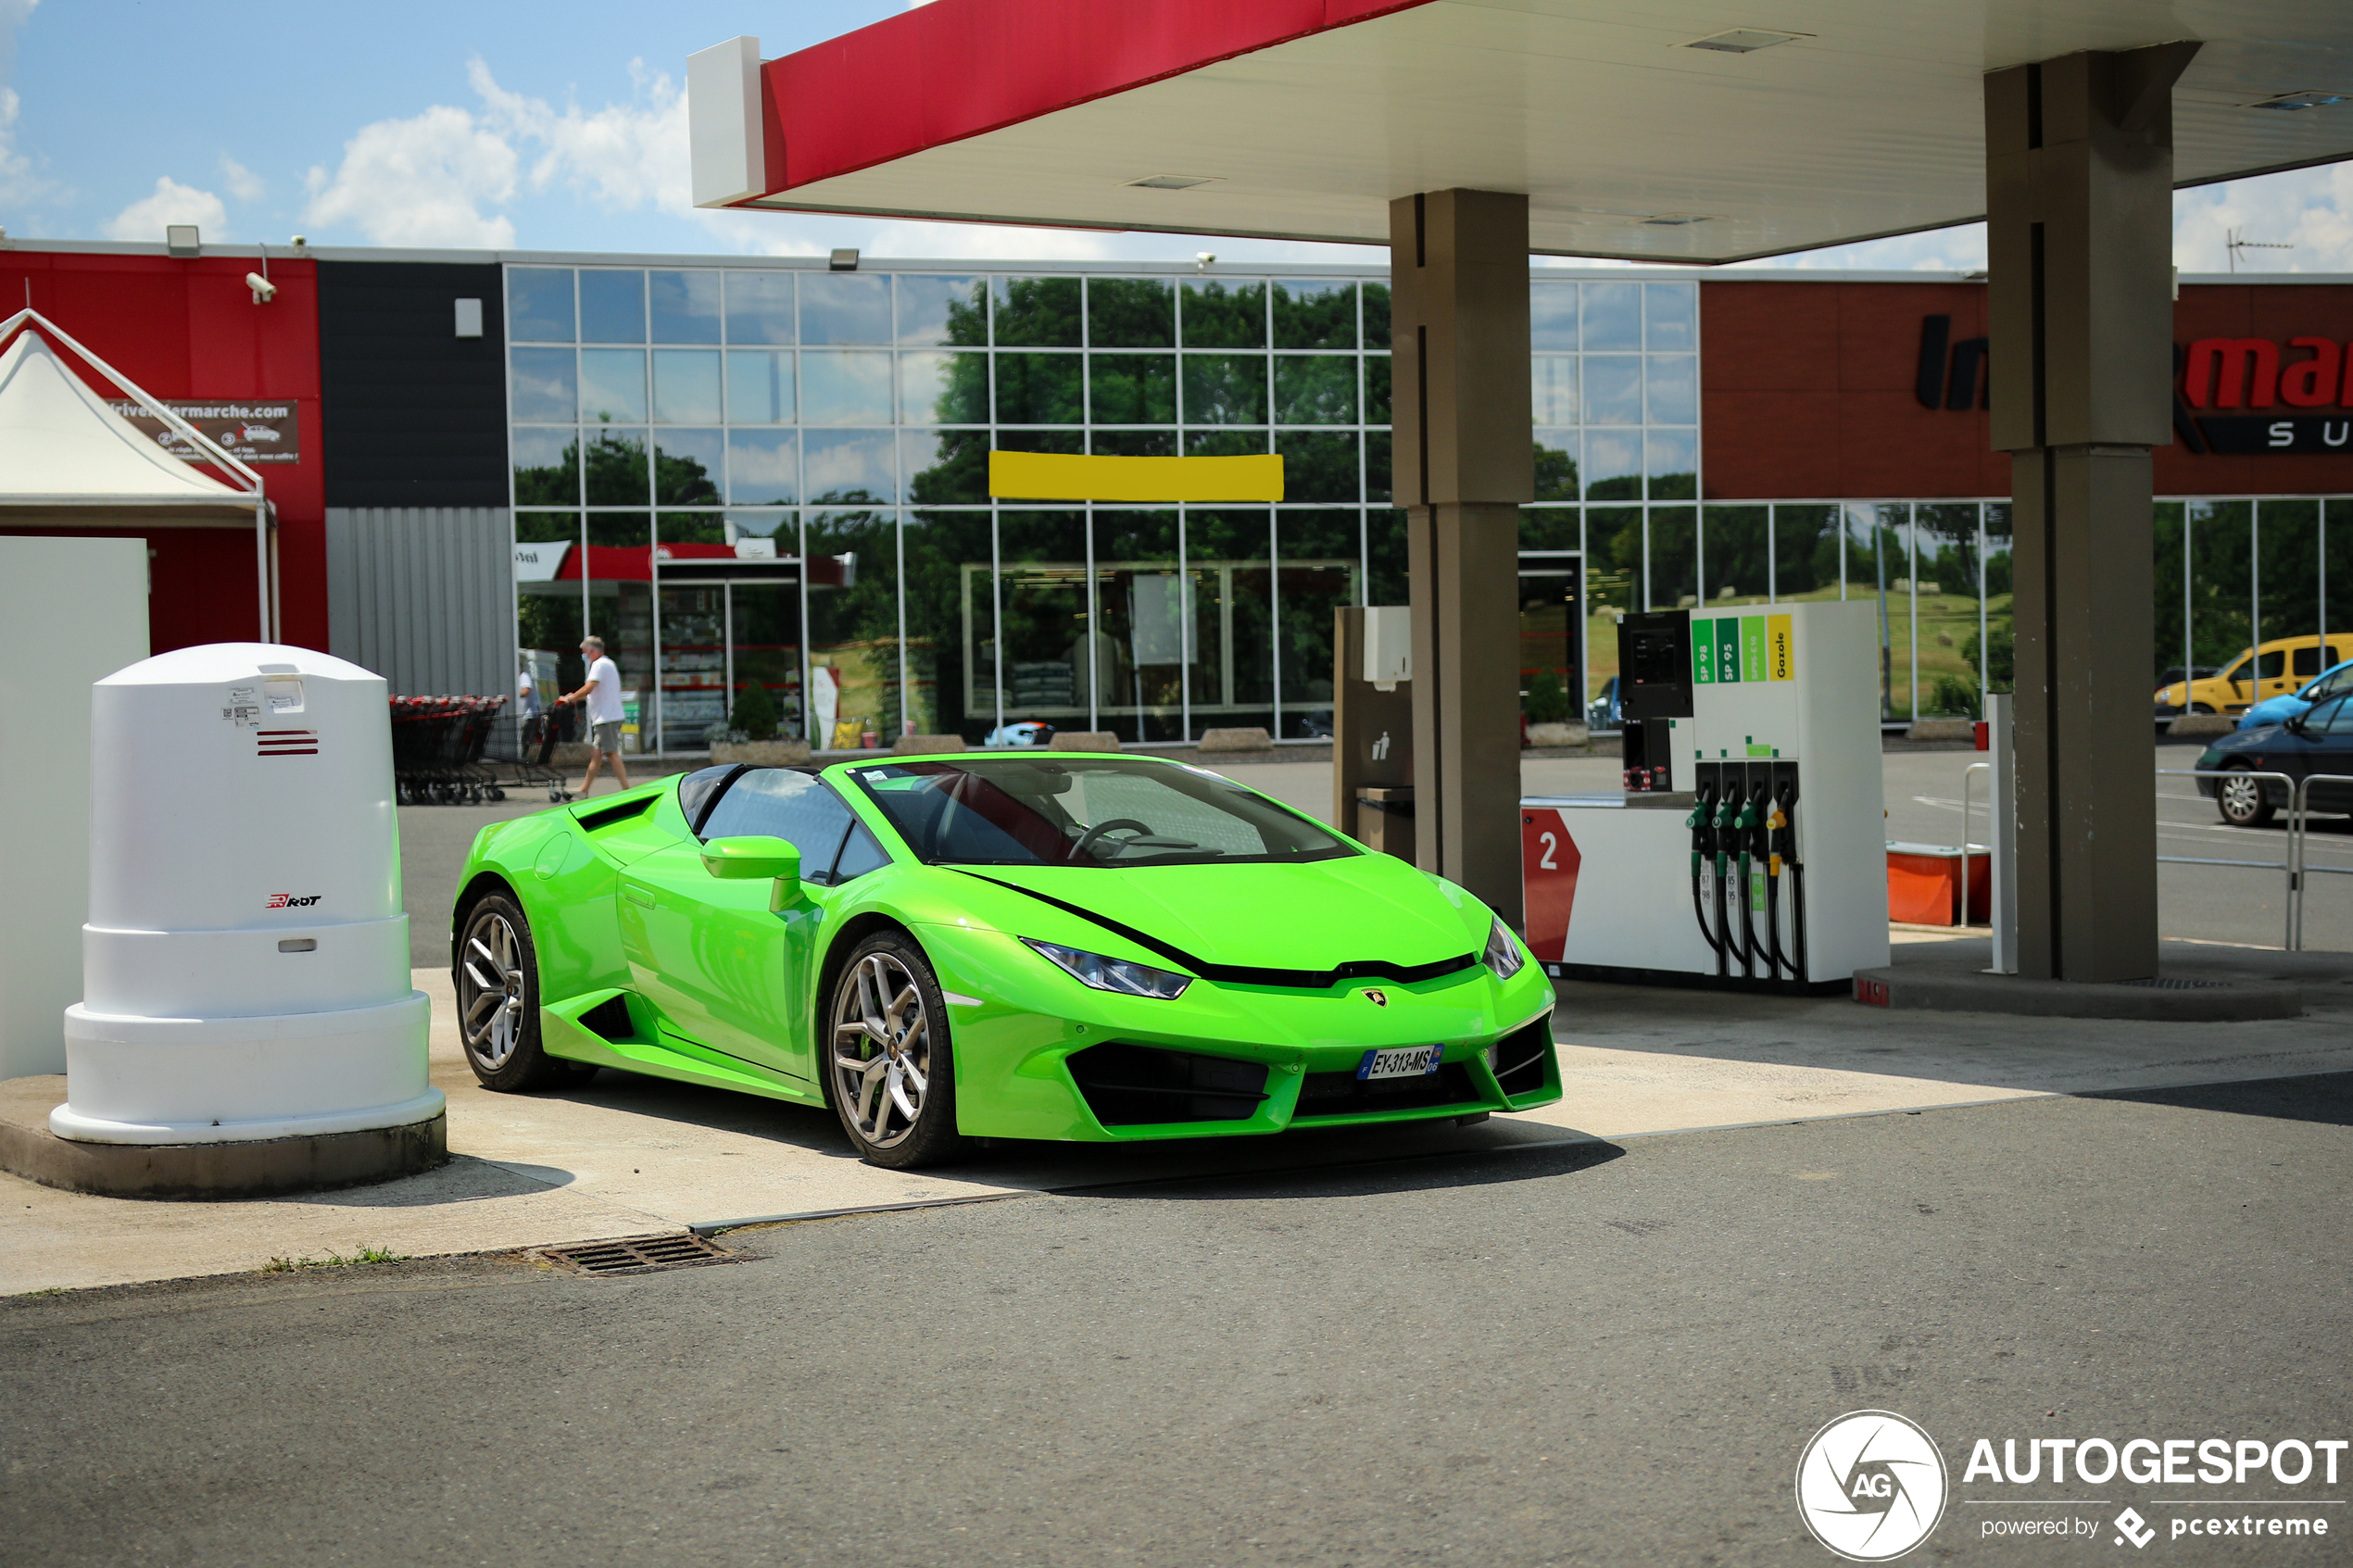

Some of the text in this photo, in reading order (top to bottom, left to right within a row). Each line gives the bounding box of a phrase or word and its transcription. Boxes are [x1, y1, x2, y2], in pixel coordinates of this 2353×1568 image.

[1699, 645, 1709, 682] SP 98
[1723, 643, 1733, 681] SP 95
[1776, 633, 1785, 678] Gazole
[1540, 831, 1557, 870] 2
[1372, 1050, 1430, 1073] EY-313-MS
[1428, 1062, 1438, 1073] 06
